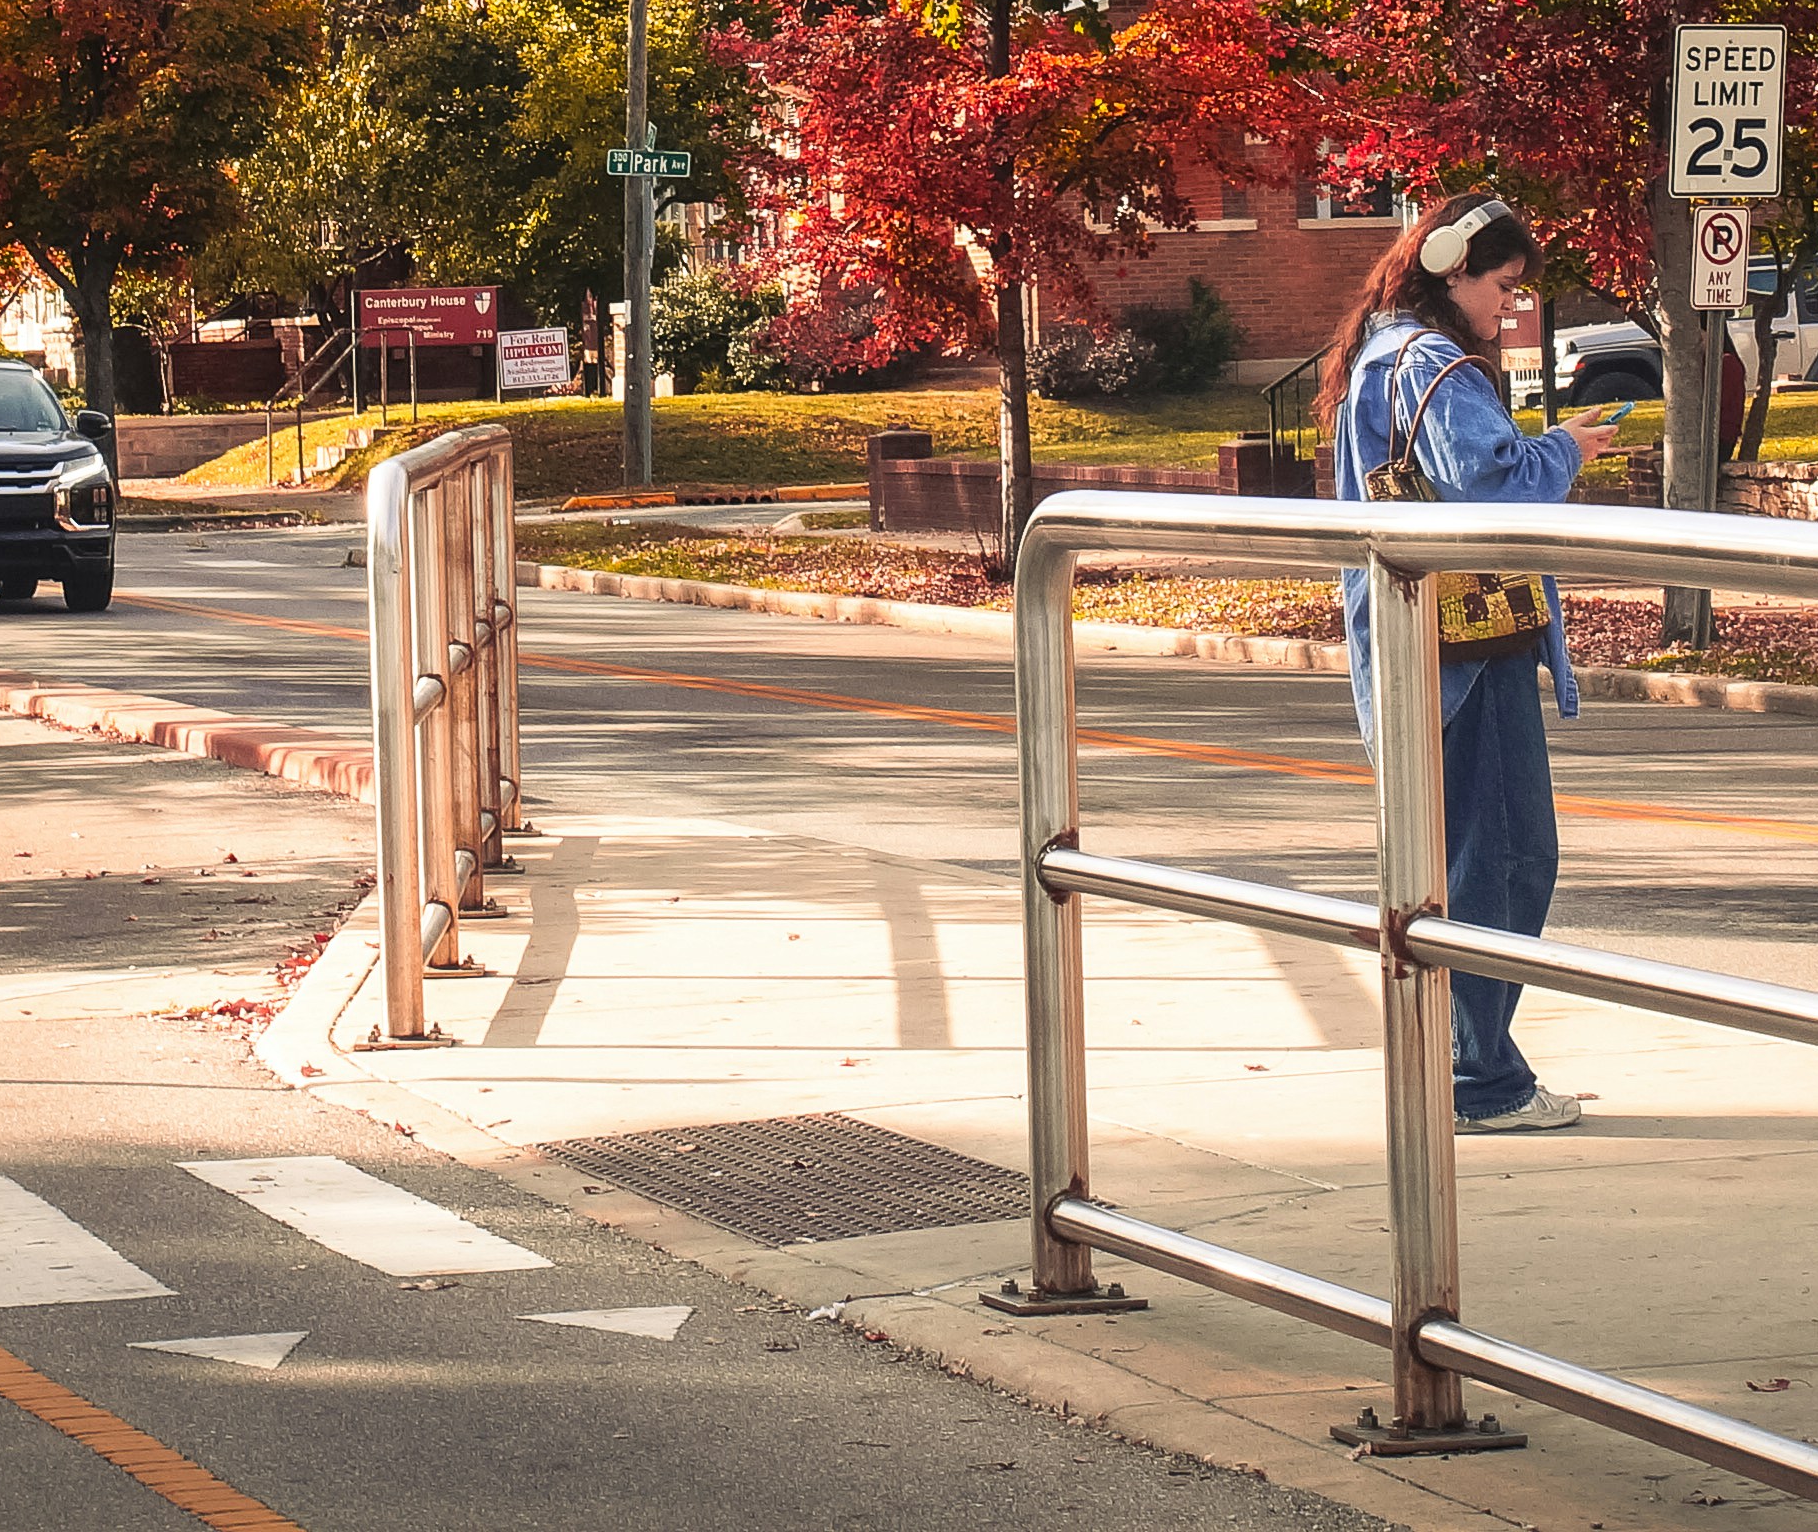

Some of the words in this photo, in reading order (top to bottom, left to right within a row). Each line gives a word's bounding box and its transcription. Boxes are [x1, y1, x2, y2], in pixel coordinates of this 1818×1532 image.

[1685, 46, 1776, 71] SPEED
[1693, 81, 1764, 106] LIMIT
[1685, 117, 1769, 178] 25
[634, 154, 668, 173] Park
[671, 160, 686, 170] Ave
[1708, 271, 1731, 285] ANY
[365, 296, 427, 309] Canterbury
[431, 295, 466, 306] House
[1706, 289, 1732, 303] TIME
[377, 316, 416, 326] Episcopal
[423, 331, 455, 340] Ministry
[476, 329, 493, 339] 719
[510, 335, 528, 345] For
[532, 334, 556, 344] Rent
[505, 344, 562, 359] HPIU.COM
